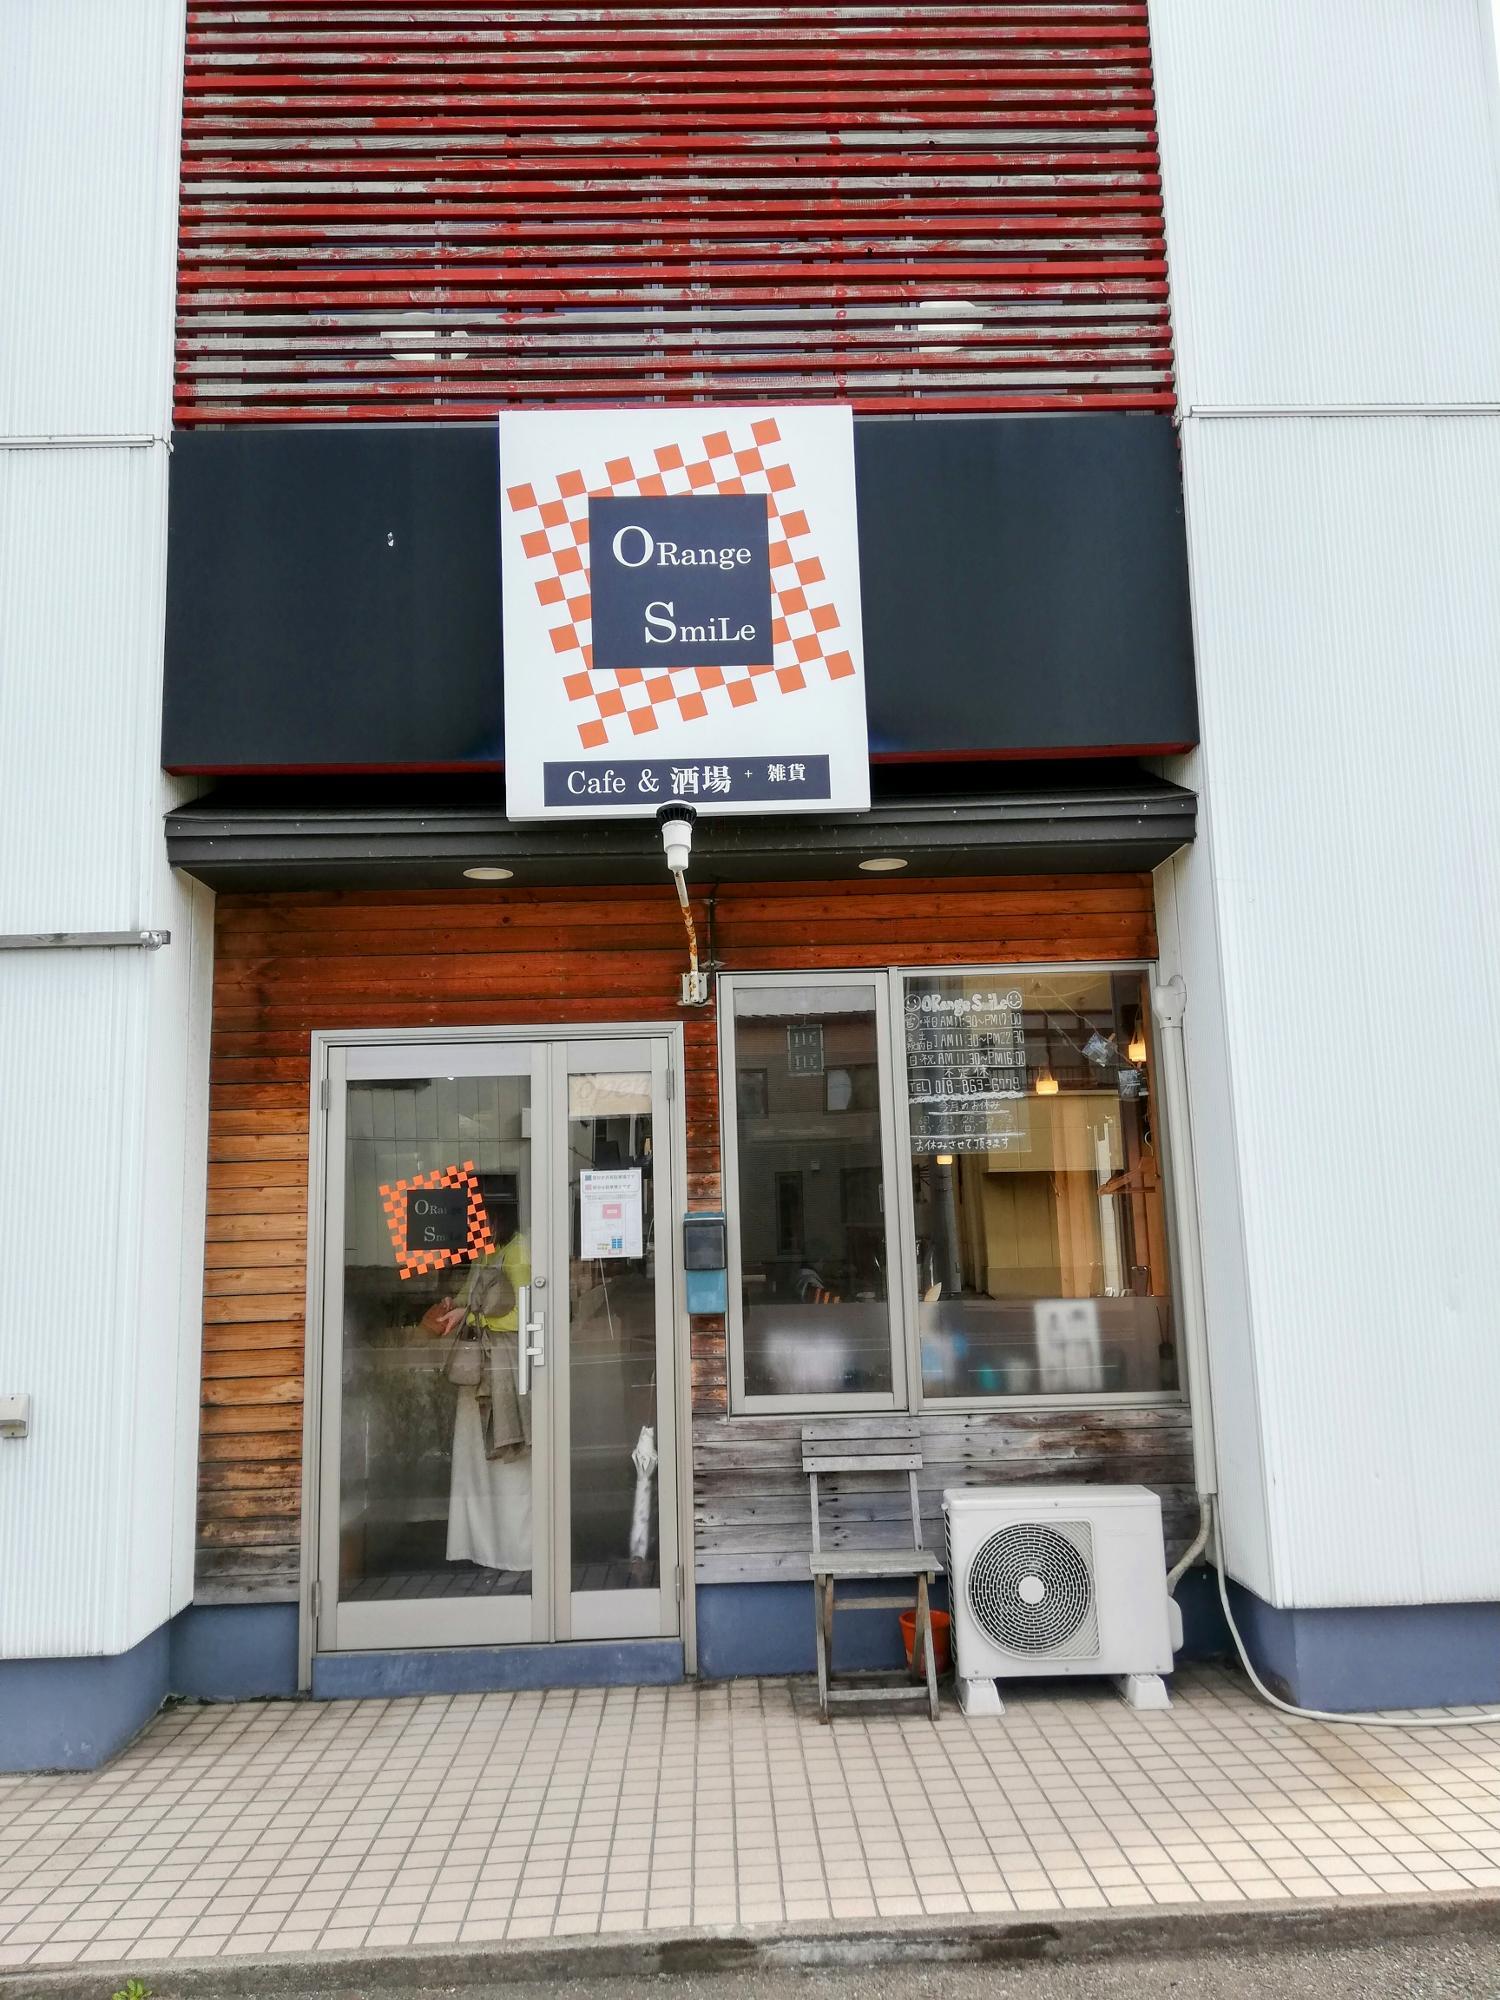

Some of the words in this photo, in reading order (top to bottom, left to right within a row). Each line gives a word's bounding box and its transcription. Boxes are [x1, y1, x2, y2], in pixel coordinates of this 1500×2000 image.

[612, 525, 752, 570] ORange
[644, 601, 756, 644] SmiLe
[567, 770, 626, 794] Cafe
[638, 768, 660, 793] &
[670, 765, 732, 795] 酒場
[767, 763, 806, 782] 雑貨
[910, 1081, 928, 1092] TEL
